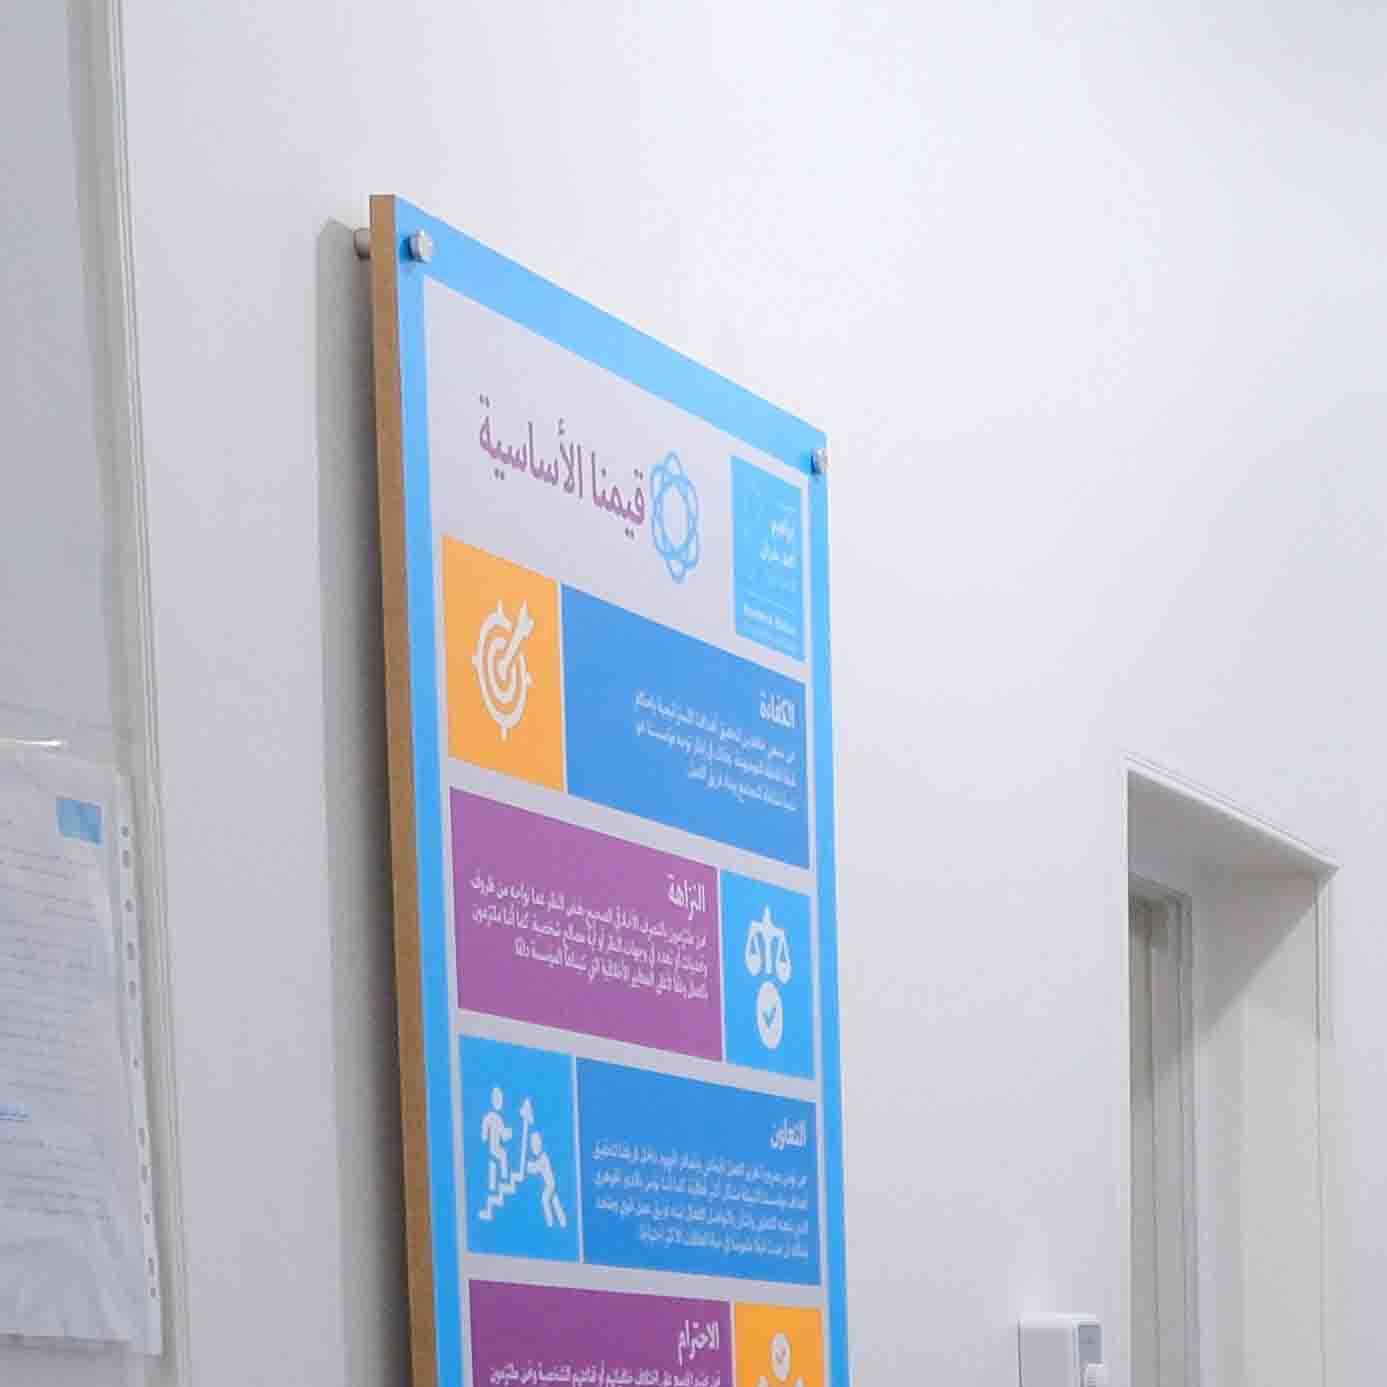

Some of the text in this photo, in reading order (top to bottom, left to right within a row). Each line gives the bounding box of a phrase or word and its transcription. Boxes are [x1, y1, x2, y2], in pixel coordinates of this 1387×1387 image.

[479, 395, 646, 537] قيمنا الأساسية
[666, 873, 705, 920] النزاهة
[678, 1320, 719, 1364] الاحترام
